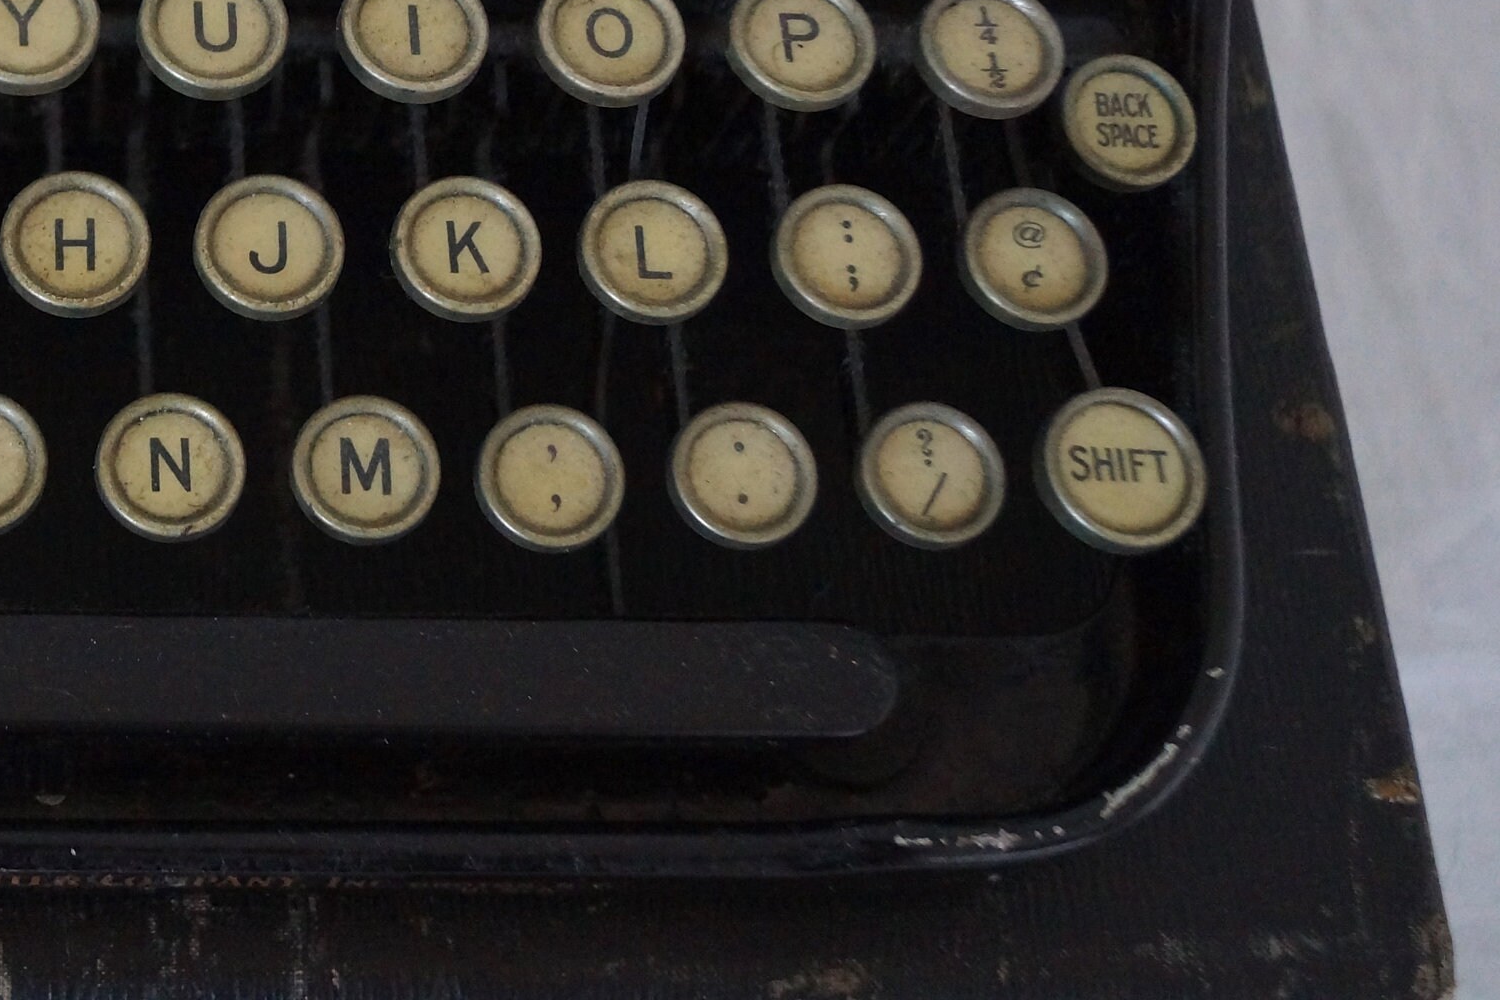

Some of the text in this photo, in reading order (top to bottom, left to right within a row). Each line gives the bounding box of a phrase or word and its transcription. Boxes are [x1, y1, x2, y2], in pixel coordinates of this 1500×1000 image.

[193, 0, 238, 53] U
[778, 12, 820, 63] P
[1094, 92, 1153, 118] BACK
[1096, 122, 1160, 149] SPACE
[54, 217, 97, 272] H
[248, 220, 288, 275] J
[445, 220, 490, 275] K
[634, 225, 673, 280] L
[1011, 220, 1046, 249] @
[149, 437, 192, 493] N
[339, 437, 392, 496] M
[916, 428, 934, 468] ?
[1068, 444, 1168, 484] SHIFT
